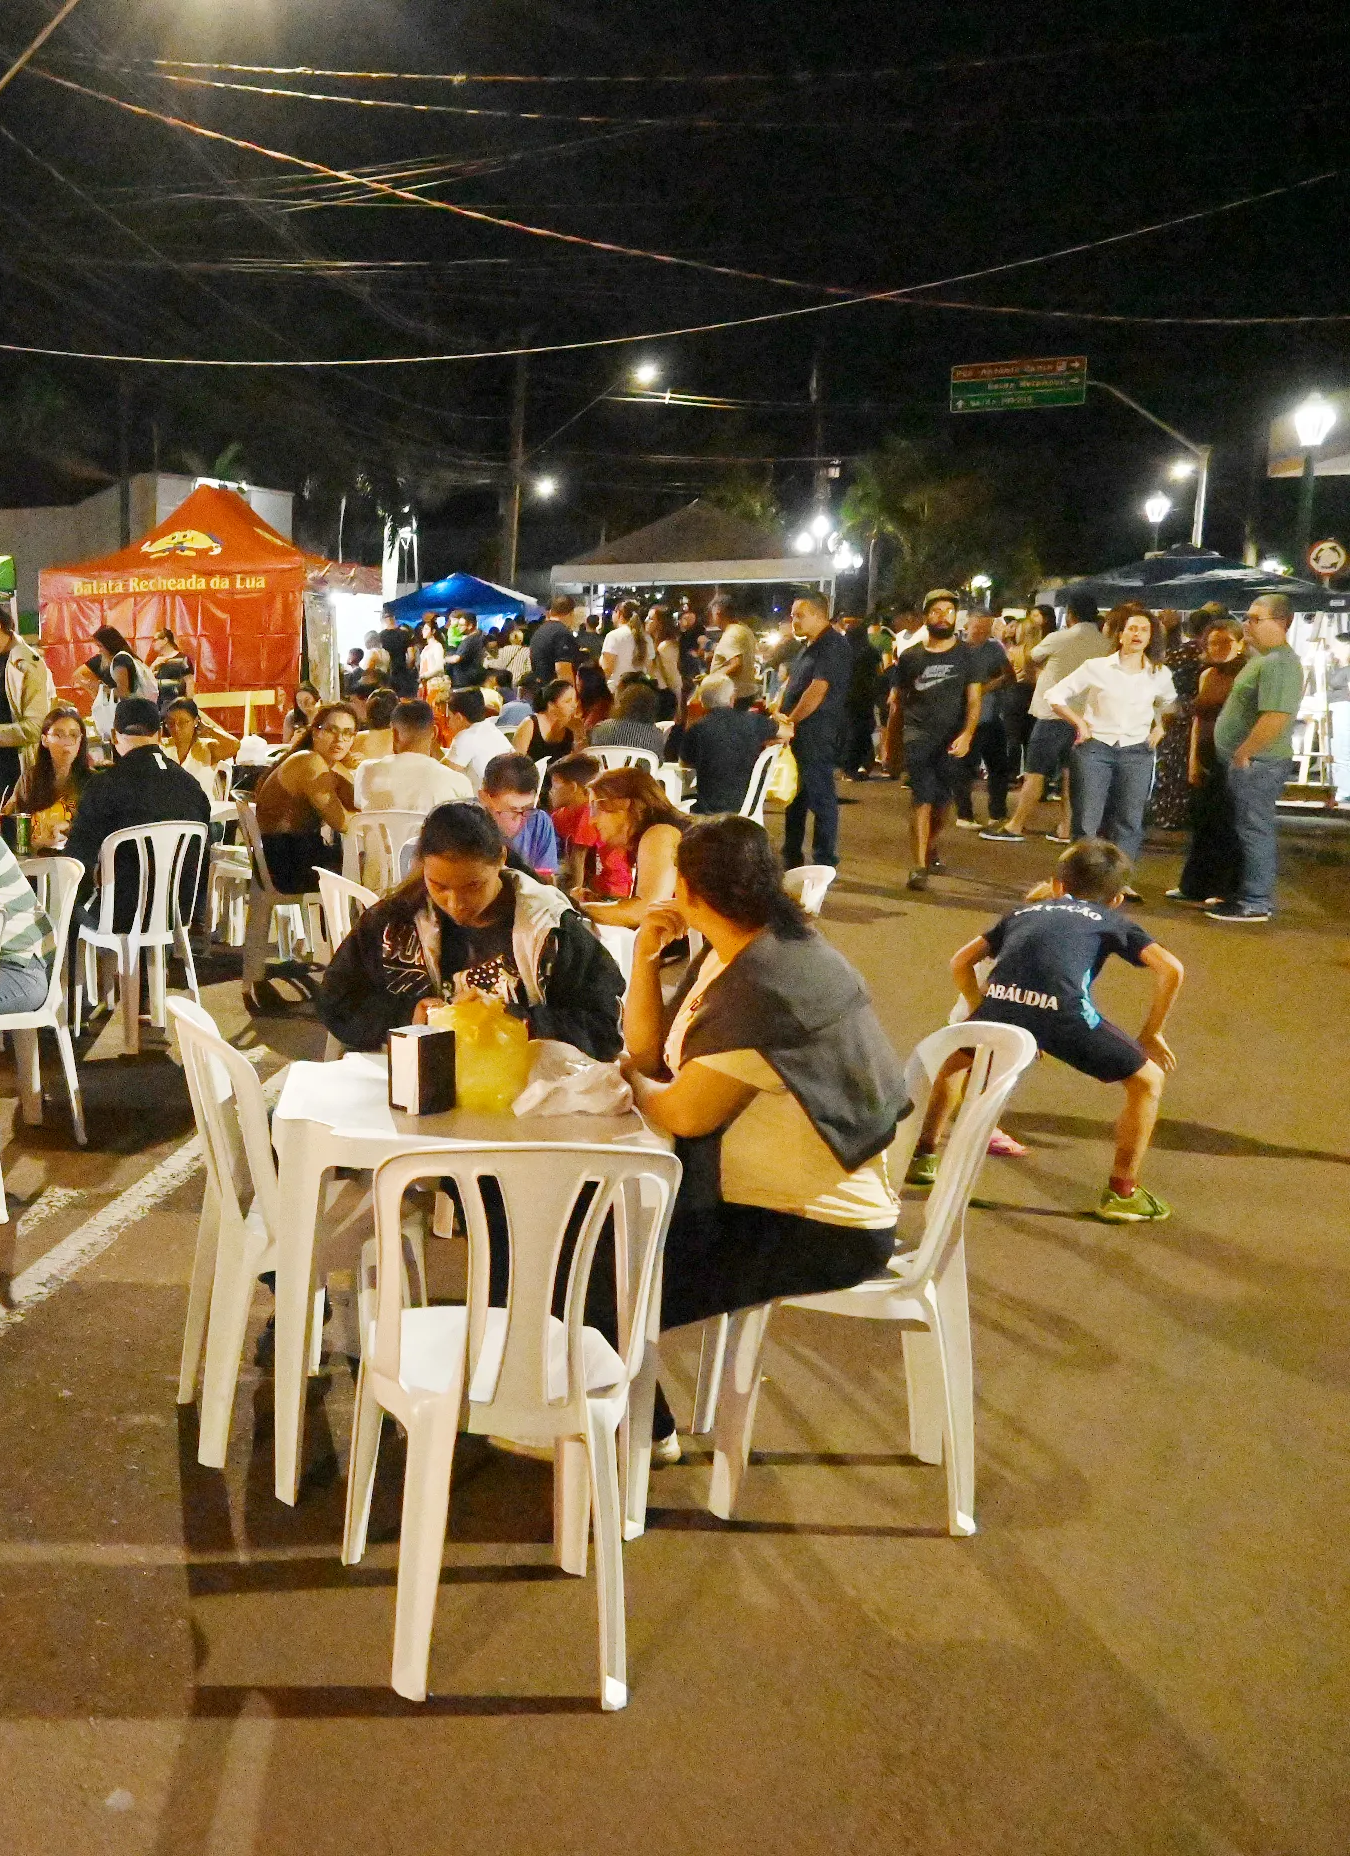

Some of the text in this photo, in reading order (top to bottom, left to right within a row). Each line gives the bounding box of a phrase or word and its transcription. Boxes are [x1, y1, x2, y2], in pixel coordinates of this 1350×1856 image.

[72, 574, 266, 597] Batata Recheada da Lua
[984, 983, 1059, 1011] ABÁUDIA
